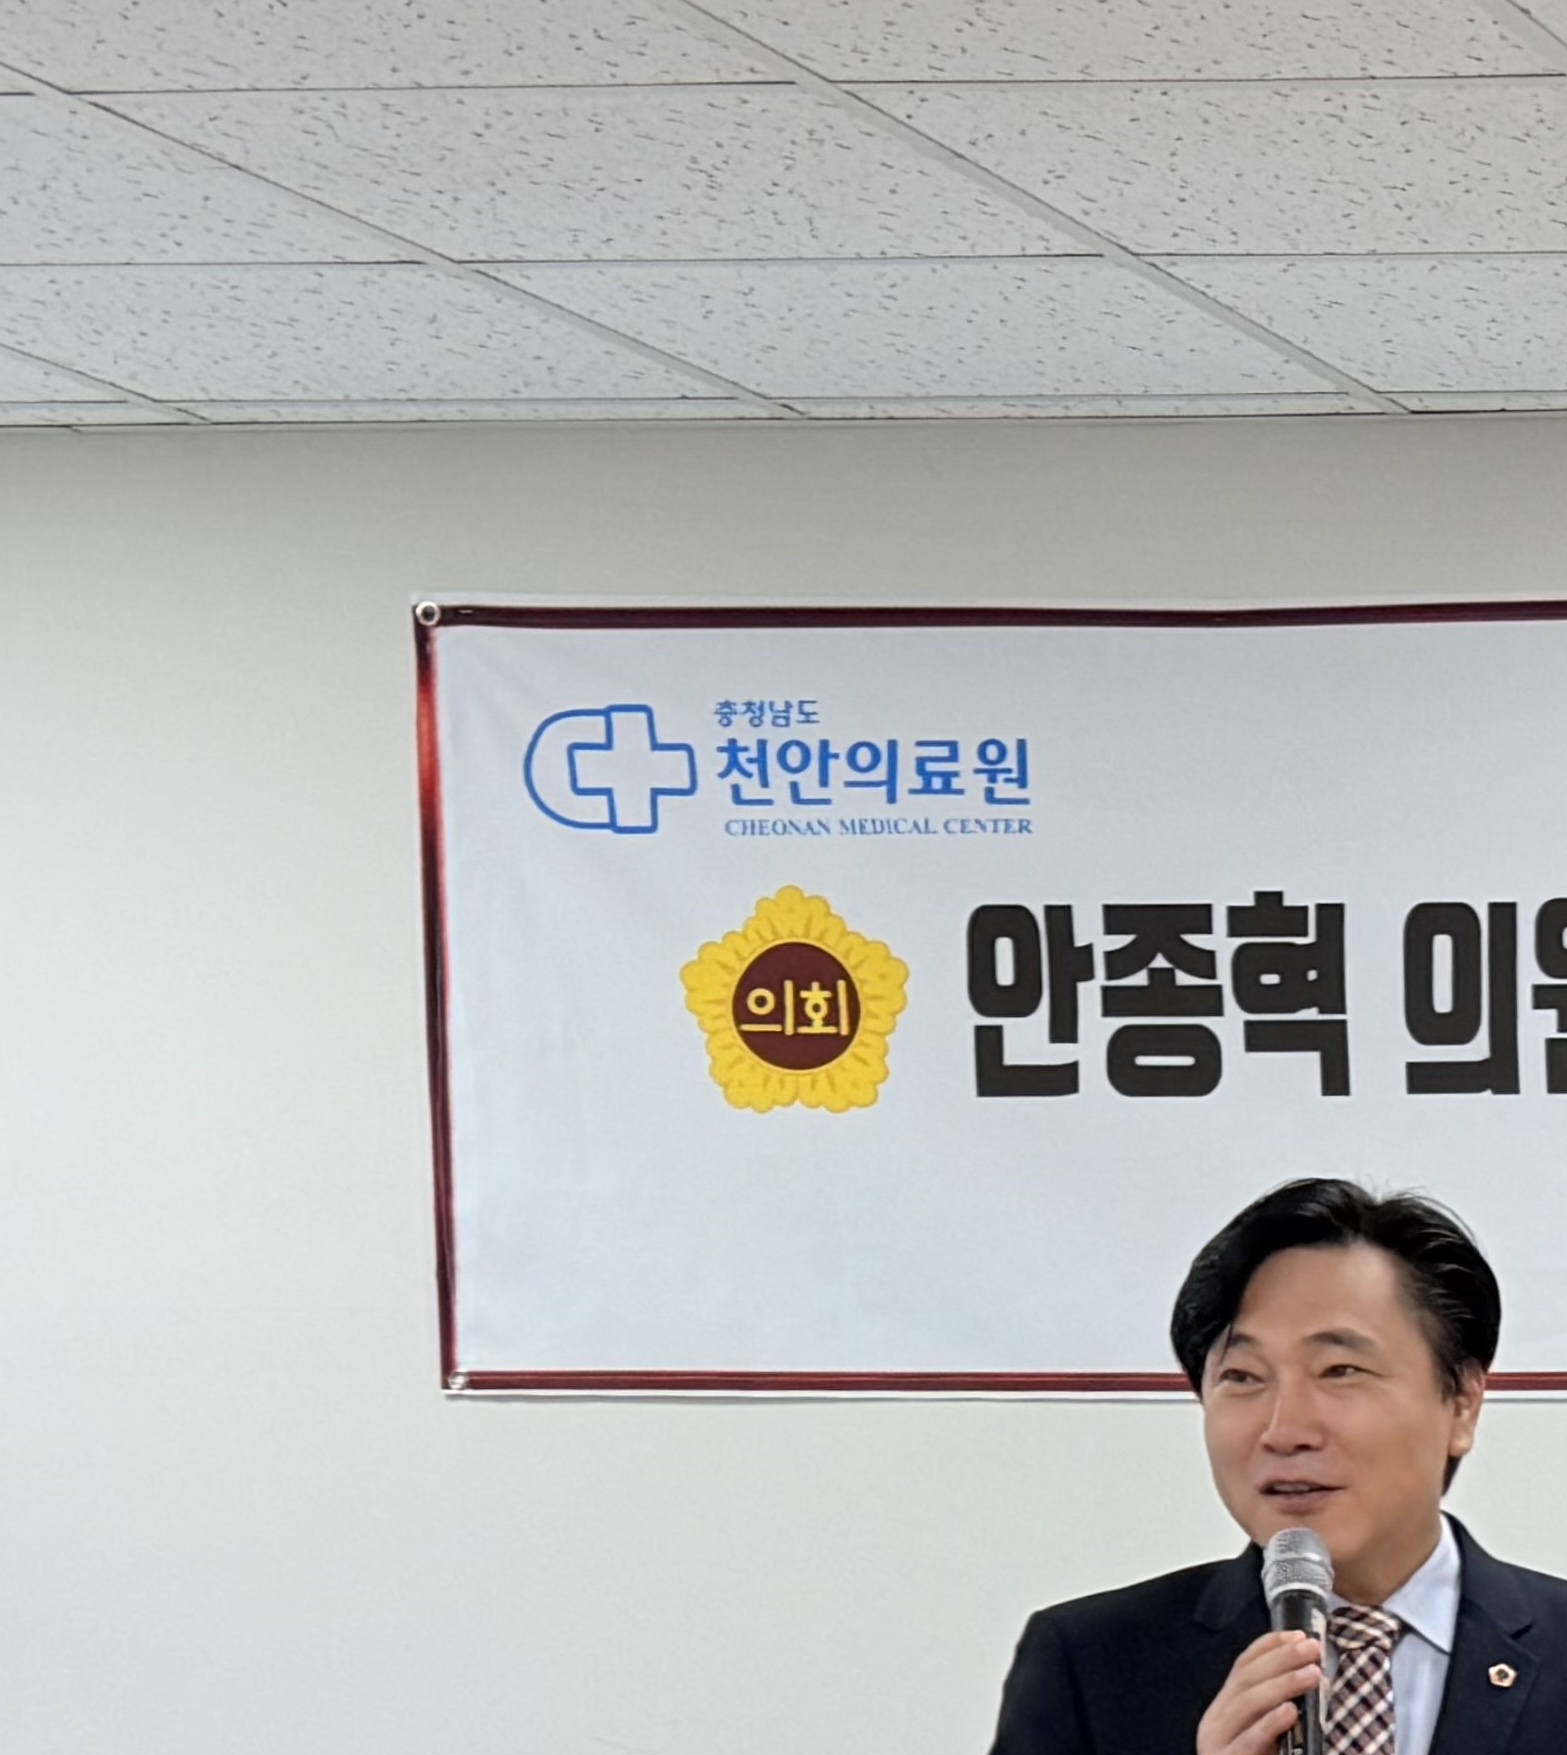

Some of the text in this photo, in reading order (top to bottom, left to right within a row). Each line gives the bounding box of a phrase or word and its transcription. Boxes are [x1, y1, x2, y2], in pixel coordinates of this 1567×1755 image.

[715, 700, 821, 727] 충청남도
[716, 738, 1032, 805] 천안의료원
[725, 818, 1034, 836] CHEONAN MEDICAL CENTER
[738, 980, 851, 1036] 의회
[966, 890, 1352, 1098] 안종혁
